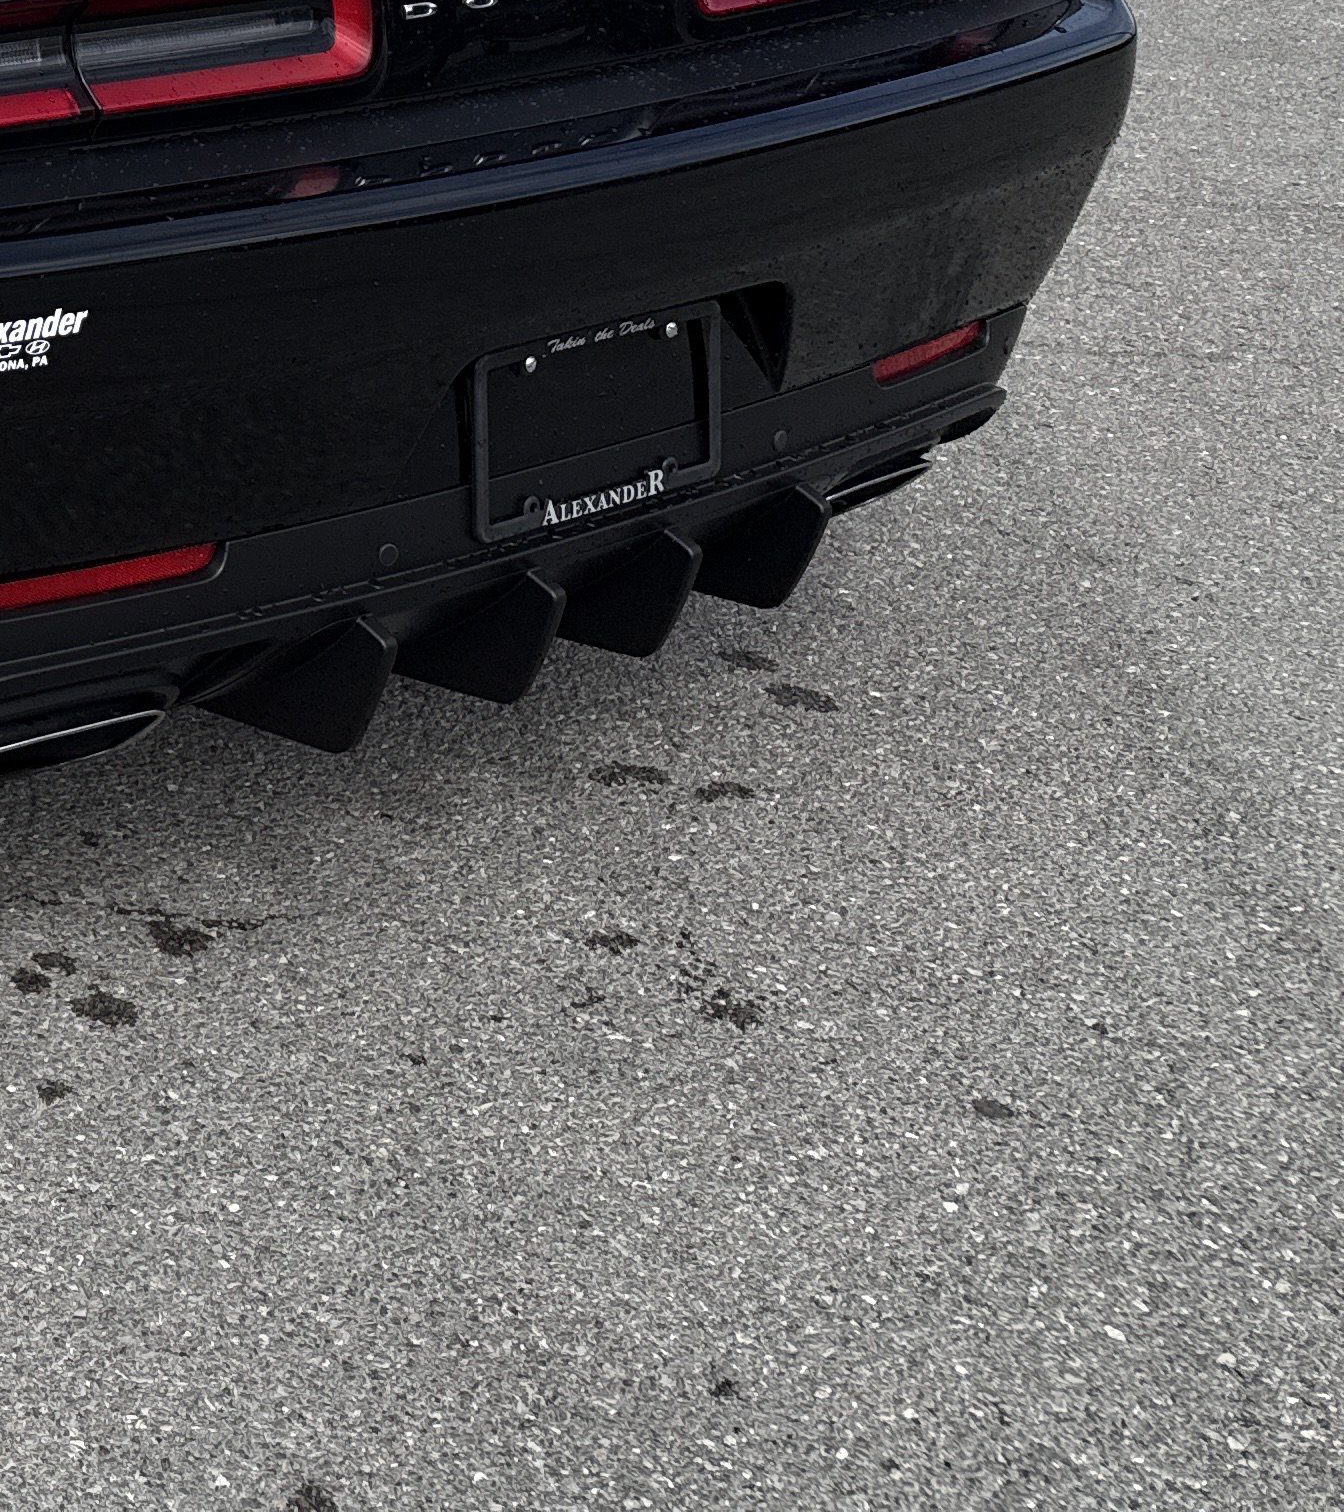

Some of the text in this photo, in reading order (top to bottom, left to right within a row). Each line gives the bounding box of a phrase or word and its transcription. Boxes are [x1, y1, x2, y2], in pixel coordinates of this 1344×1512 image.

[594, 328, 614, 342] the
[619, 318, 655, 336] Deals
[32, 355, 48, 367] PA
